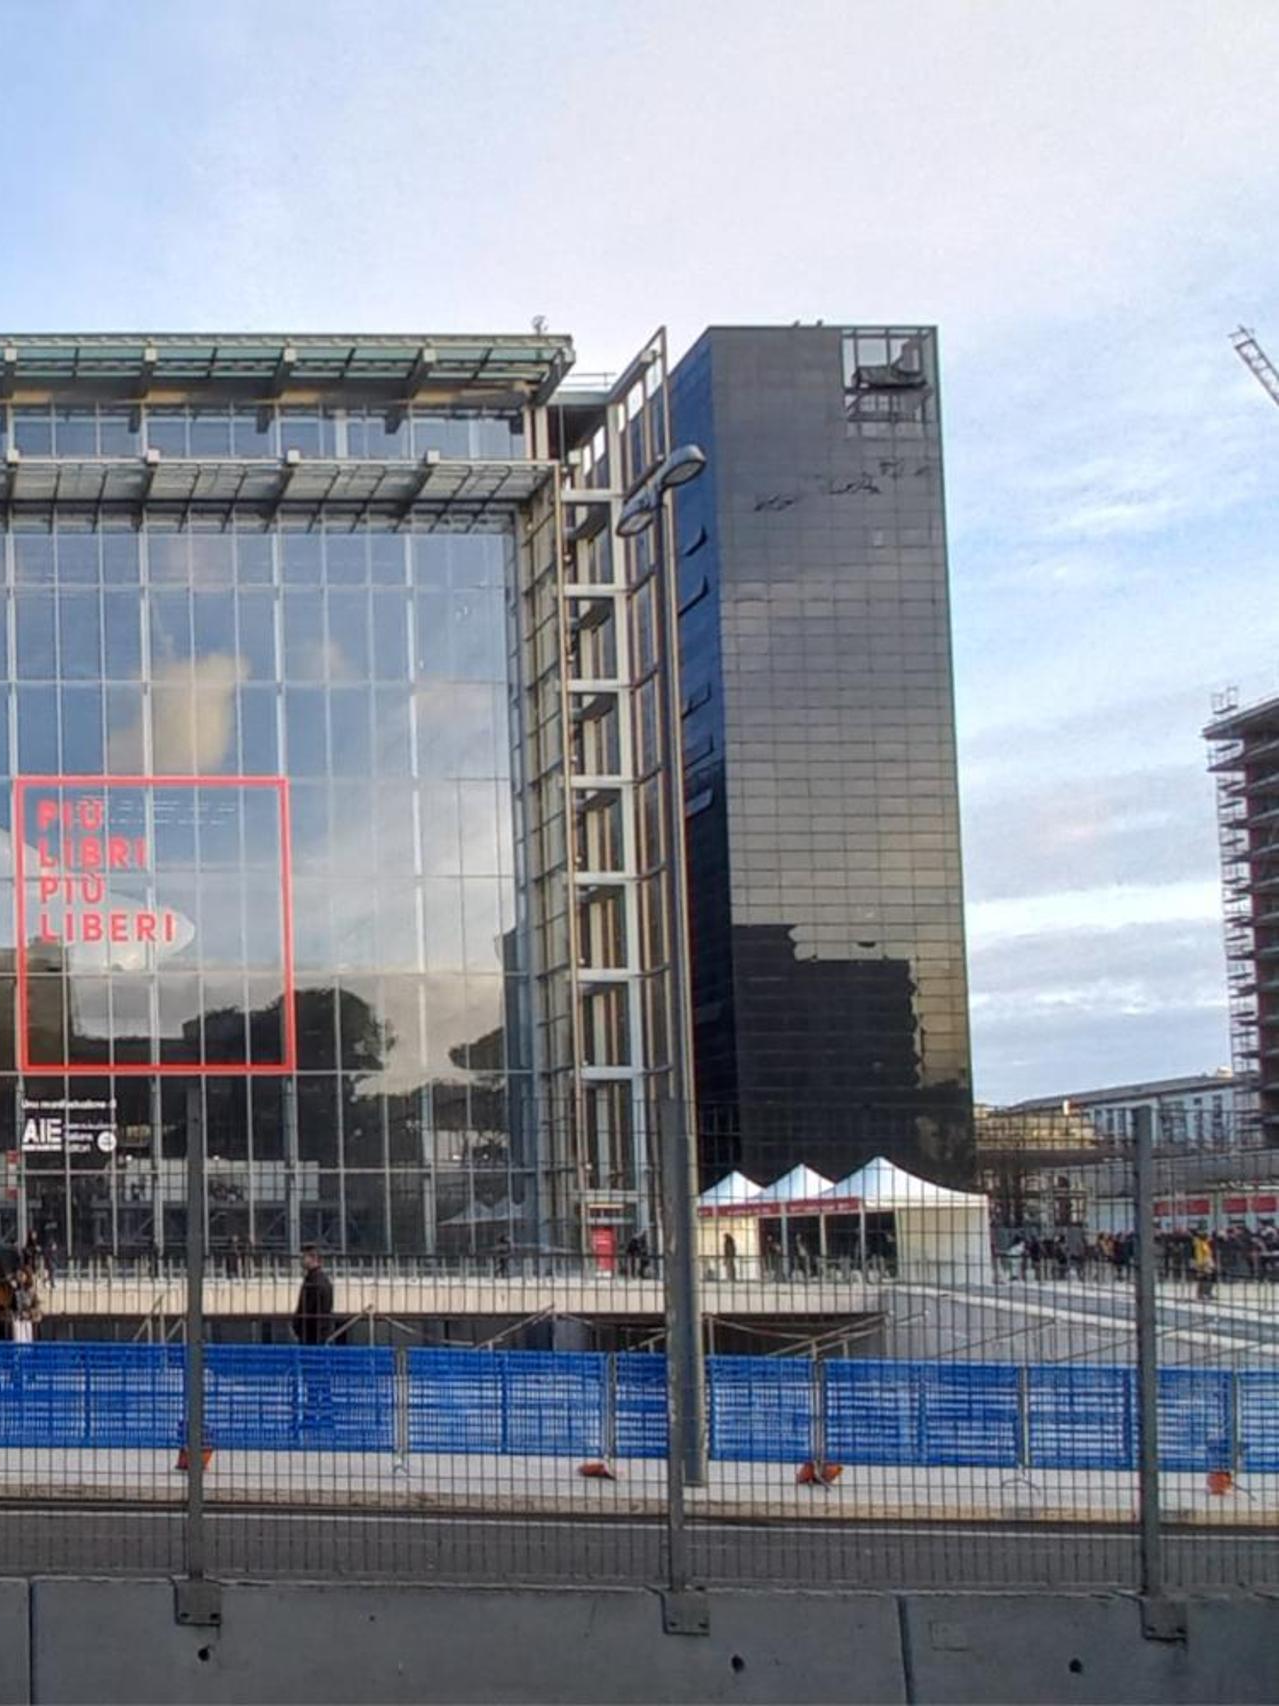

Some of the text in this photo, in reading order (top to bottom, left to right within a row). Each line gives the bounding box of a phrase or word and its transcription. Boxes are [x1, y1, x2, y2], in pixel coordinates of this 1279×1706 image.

[38, 837, 147, 868] LIBRI
[40, 872, 106, 904] PIÙ
[41, 913, 175, 941] LIBERI
[22, 1118, 62, 1143] AIE
